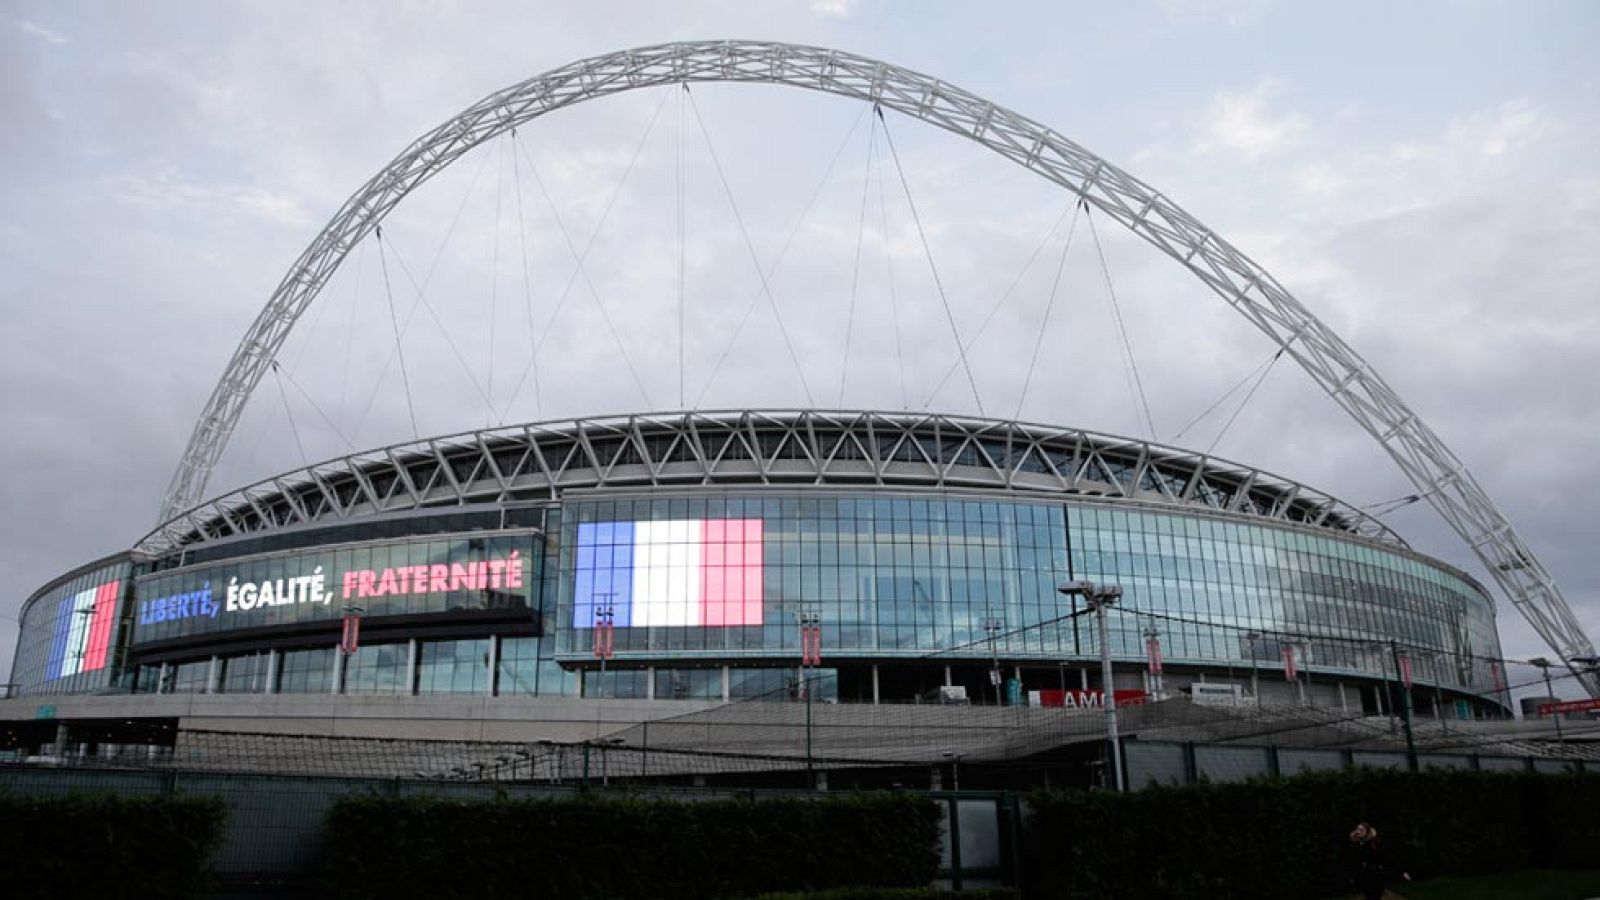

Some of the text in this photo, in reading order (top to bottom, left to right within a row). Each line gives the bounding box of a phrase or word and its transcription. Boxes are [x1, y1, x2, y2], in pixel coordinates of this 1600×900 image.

[141, 550, 523, 625] LIBERTÉ, ÉGALITÉ, FRATERNITÉ
